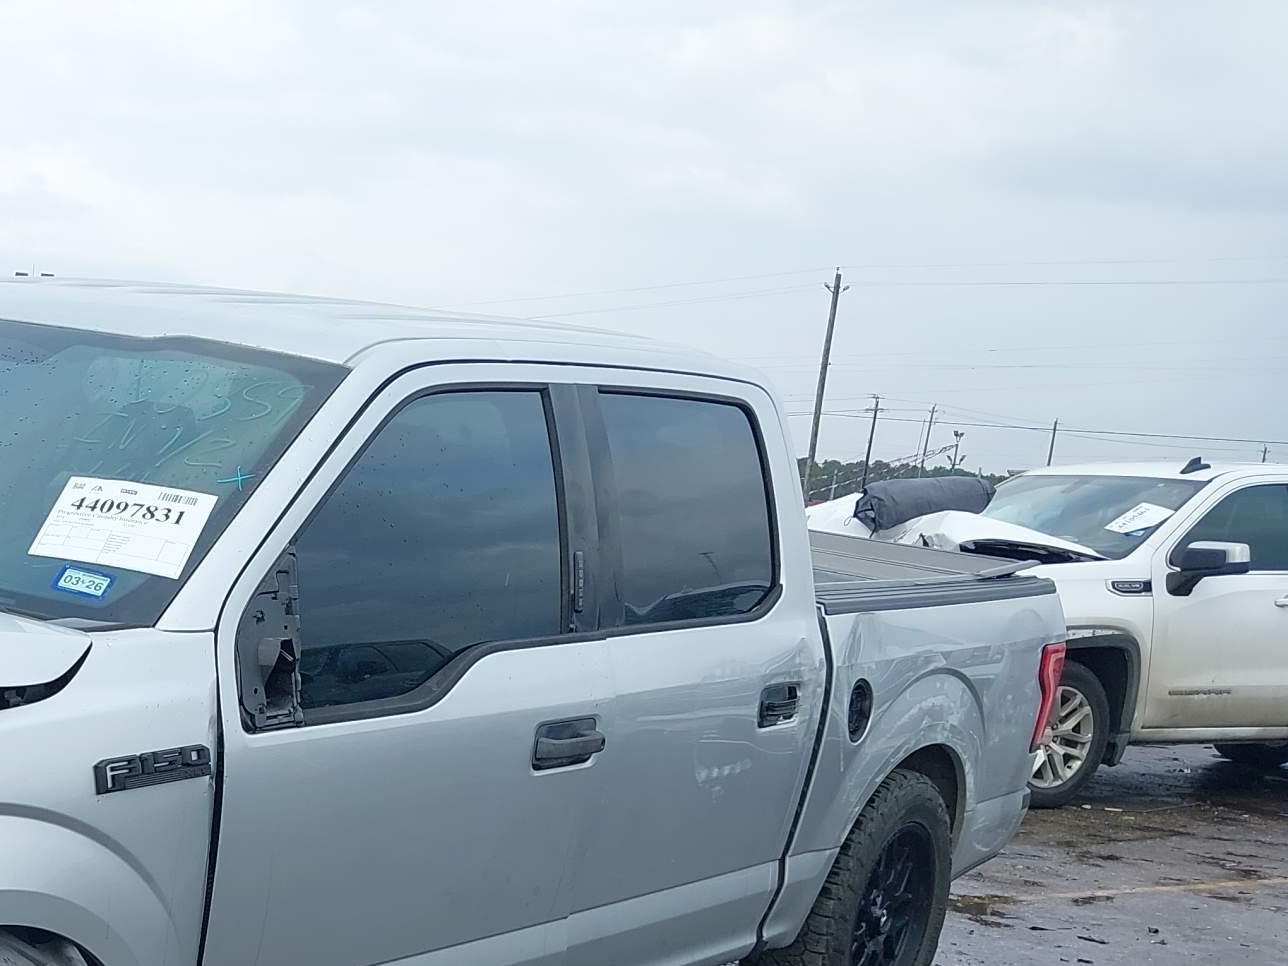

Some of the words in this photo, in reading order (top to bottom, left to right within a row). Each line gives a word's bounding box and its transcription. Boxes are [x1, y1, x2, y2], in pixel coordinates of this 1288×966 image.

[70, 496, 187, 526] 44097831
[63, 574, 81, 586] 03
[85, 580, 104, 592] 26
